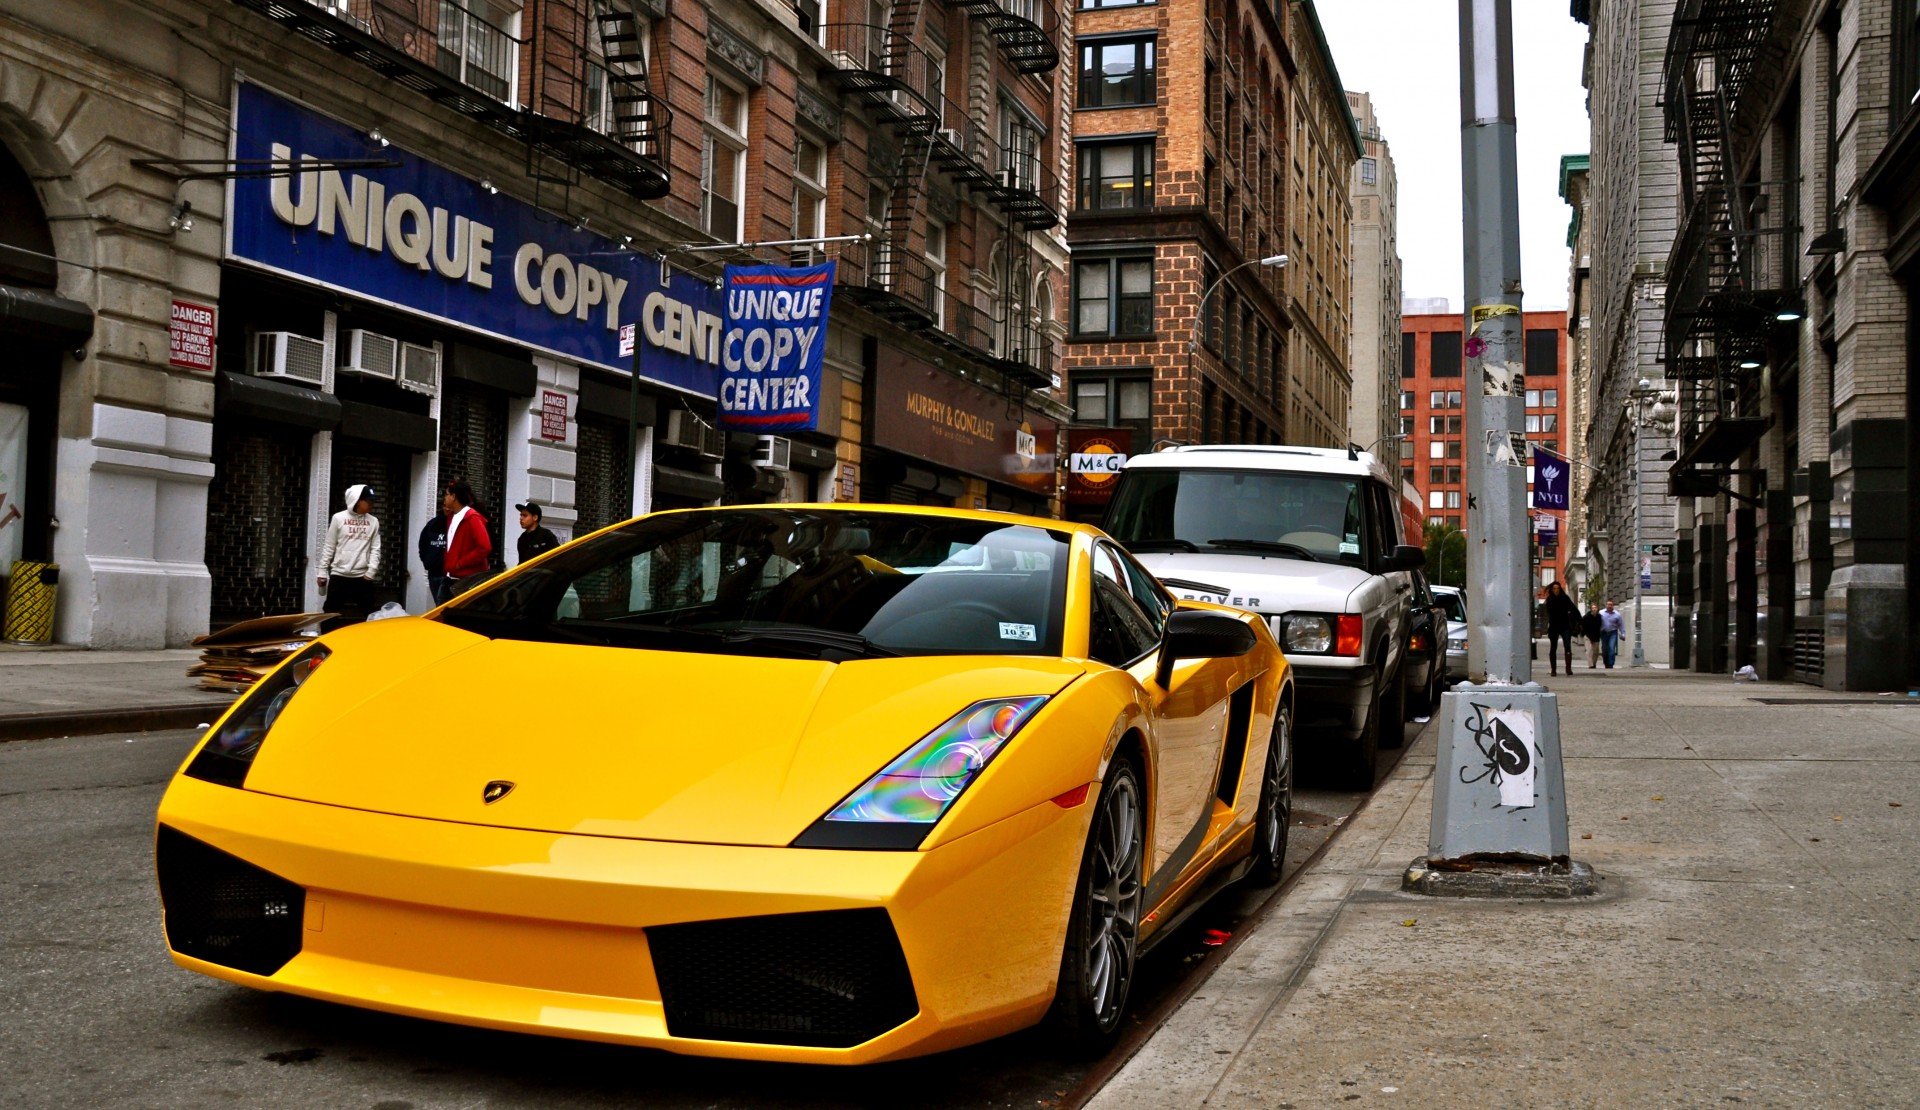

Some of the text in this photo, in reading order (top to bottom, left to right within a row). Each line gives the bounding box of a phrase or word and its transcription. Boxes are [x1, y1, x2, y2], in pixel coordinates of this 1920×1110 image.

[271, 142, 494, 289] UNIQUE
[514, 242, 628, 331] COPY
[172, 305, 212, 325] DANGER
[728, 287, 823, 321] UNIQUE
[171, 330, 210, 346] NO PARKING
[171, 340, 211, 355] NO VEHICLES
[722, 325, 819, 373] COPY
[544, 394, 566, 408] DANGER
[720, 374, 811, 411] CENTER
[906, 391, 995, 441] MURPHY & GONZALEZ
[1538, 491, 1563, 504] NYU
